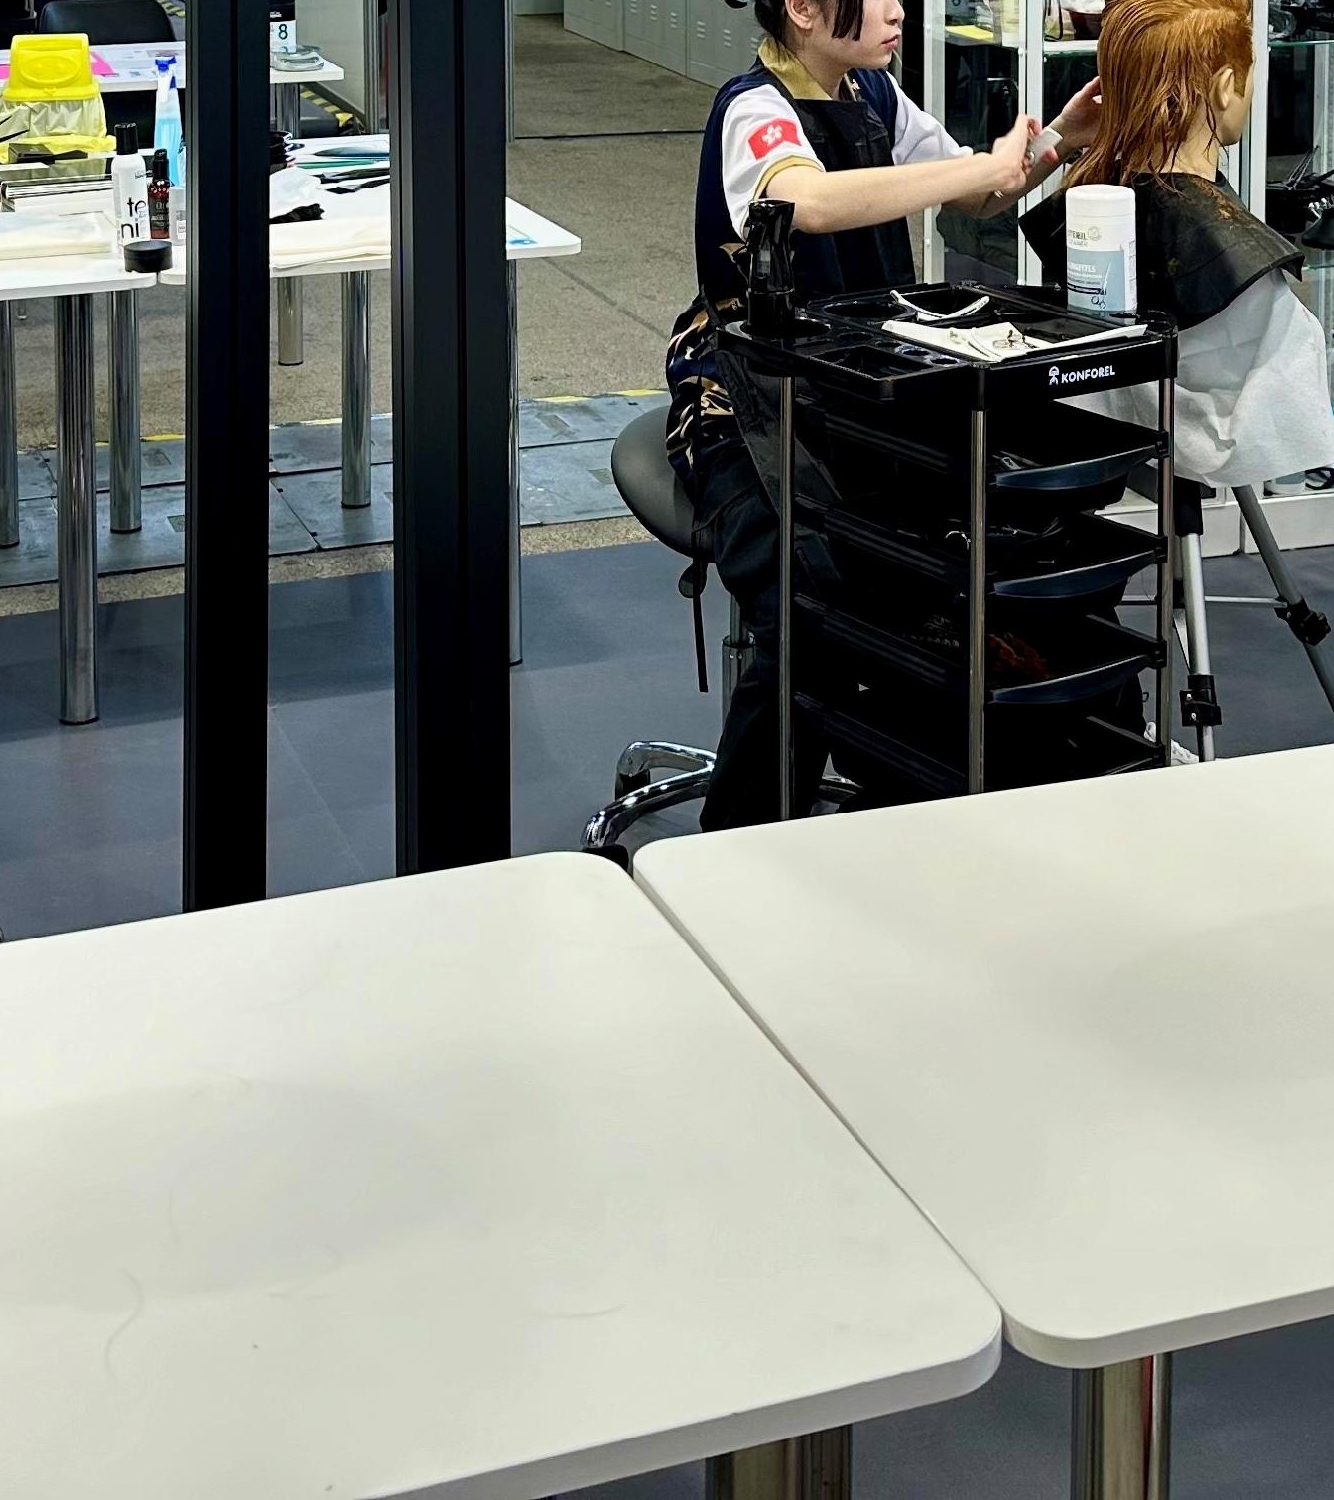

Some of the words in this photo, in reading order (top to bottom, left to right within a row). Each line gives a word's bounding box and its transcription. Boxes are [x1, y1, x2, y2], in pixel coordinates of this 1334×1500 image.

[278, 23, 288, 41] 8
[127, 196, 147, 218] te
[120, 217, 140, 239] ni
[1060, 364, 1116, 384] KONFOREL
